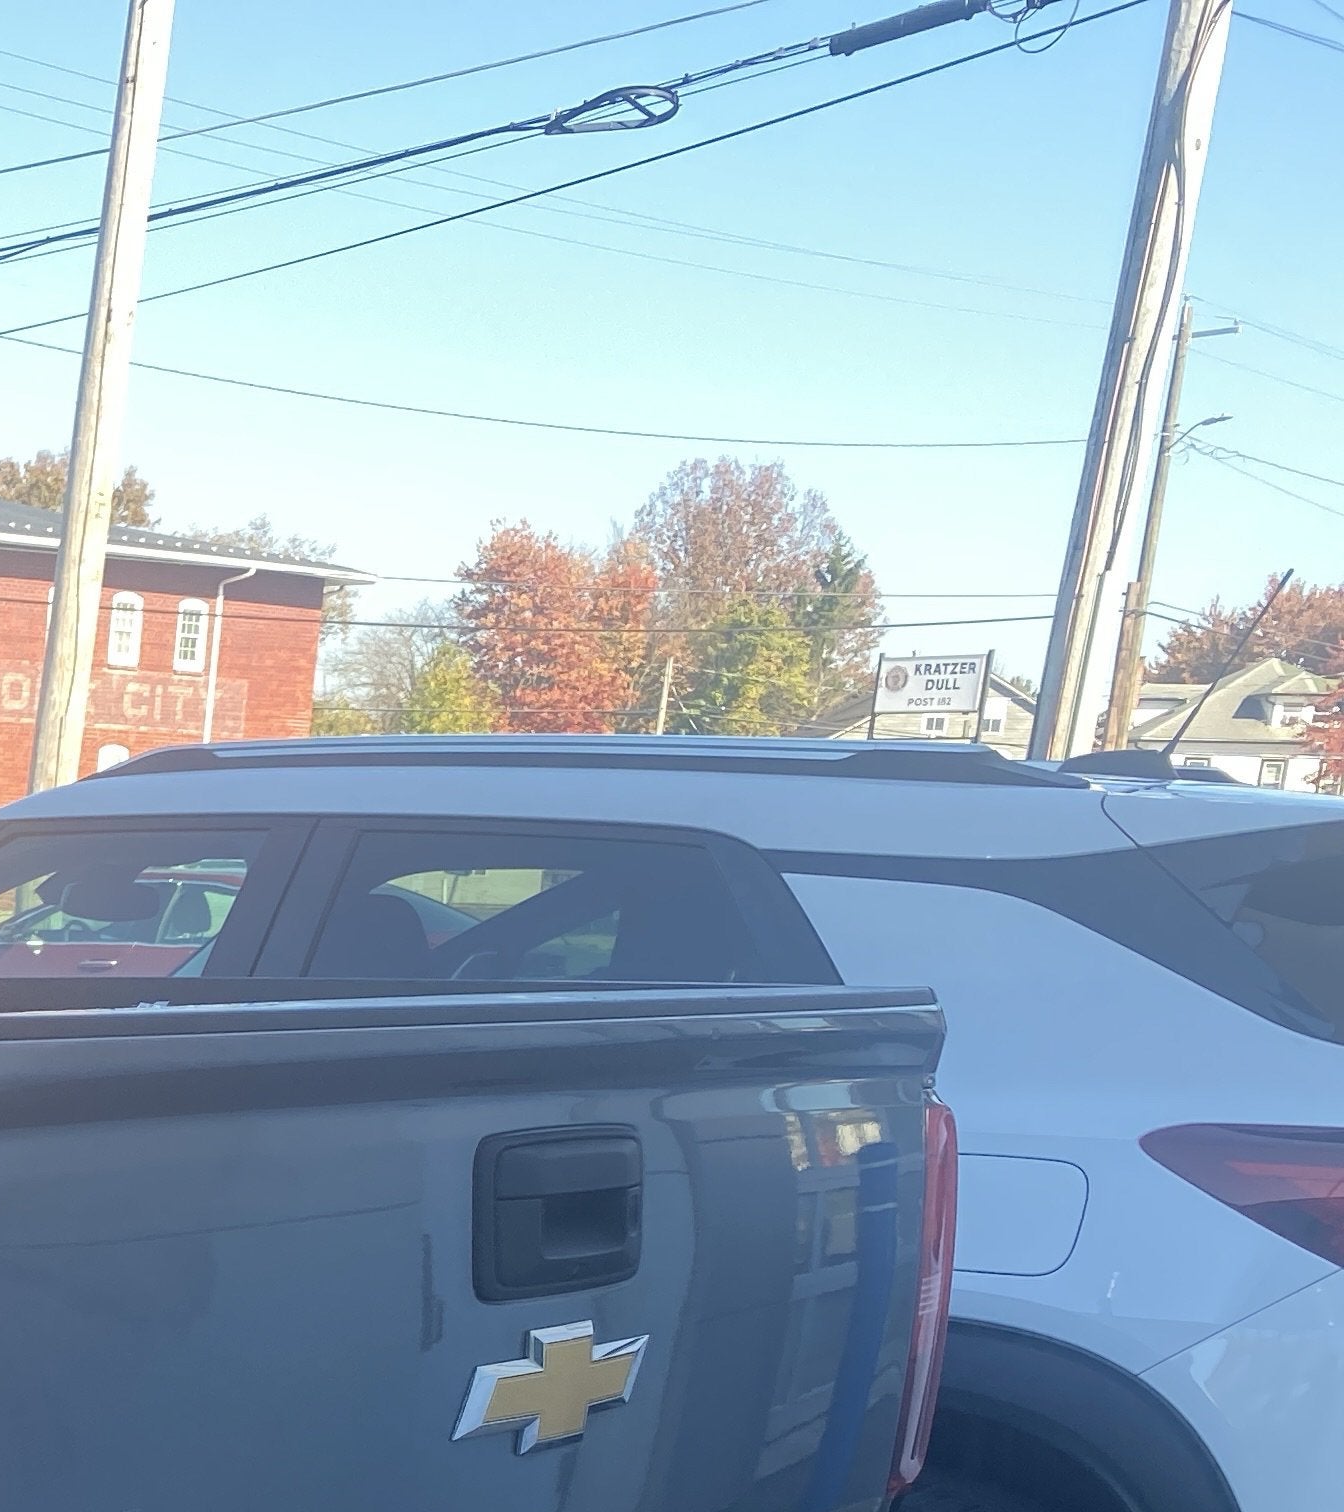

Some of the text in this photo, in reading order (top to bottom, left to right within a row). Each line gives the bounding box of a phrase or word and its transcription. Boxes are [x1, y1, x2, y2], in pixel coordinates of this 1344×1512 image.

[914, 661, 977, 676] KRATZER
[924, 677, 961, 691] DULL
[122, 680, 224, 724] CITY
[907, 697, 935, 707] POST
